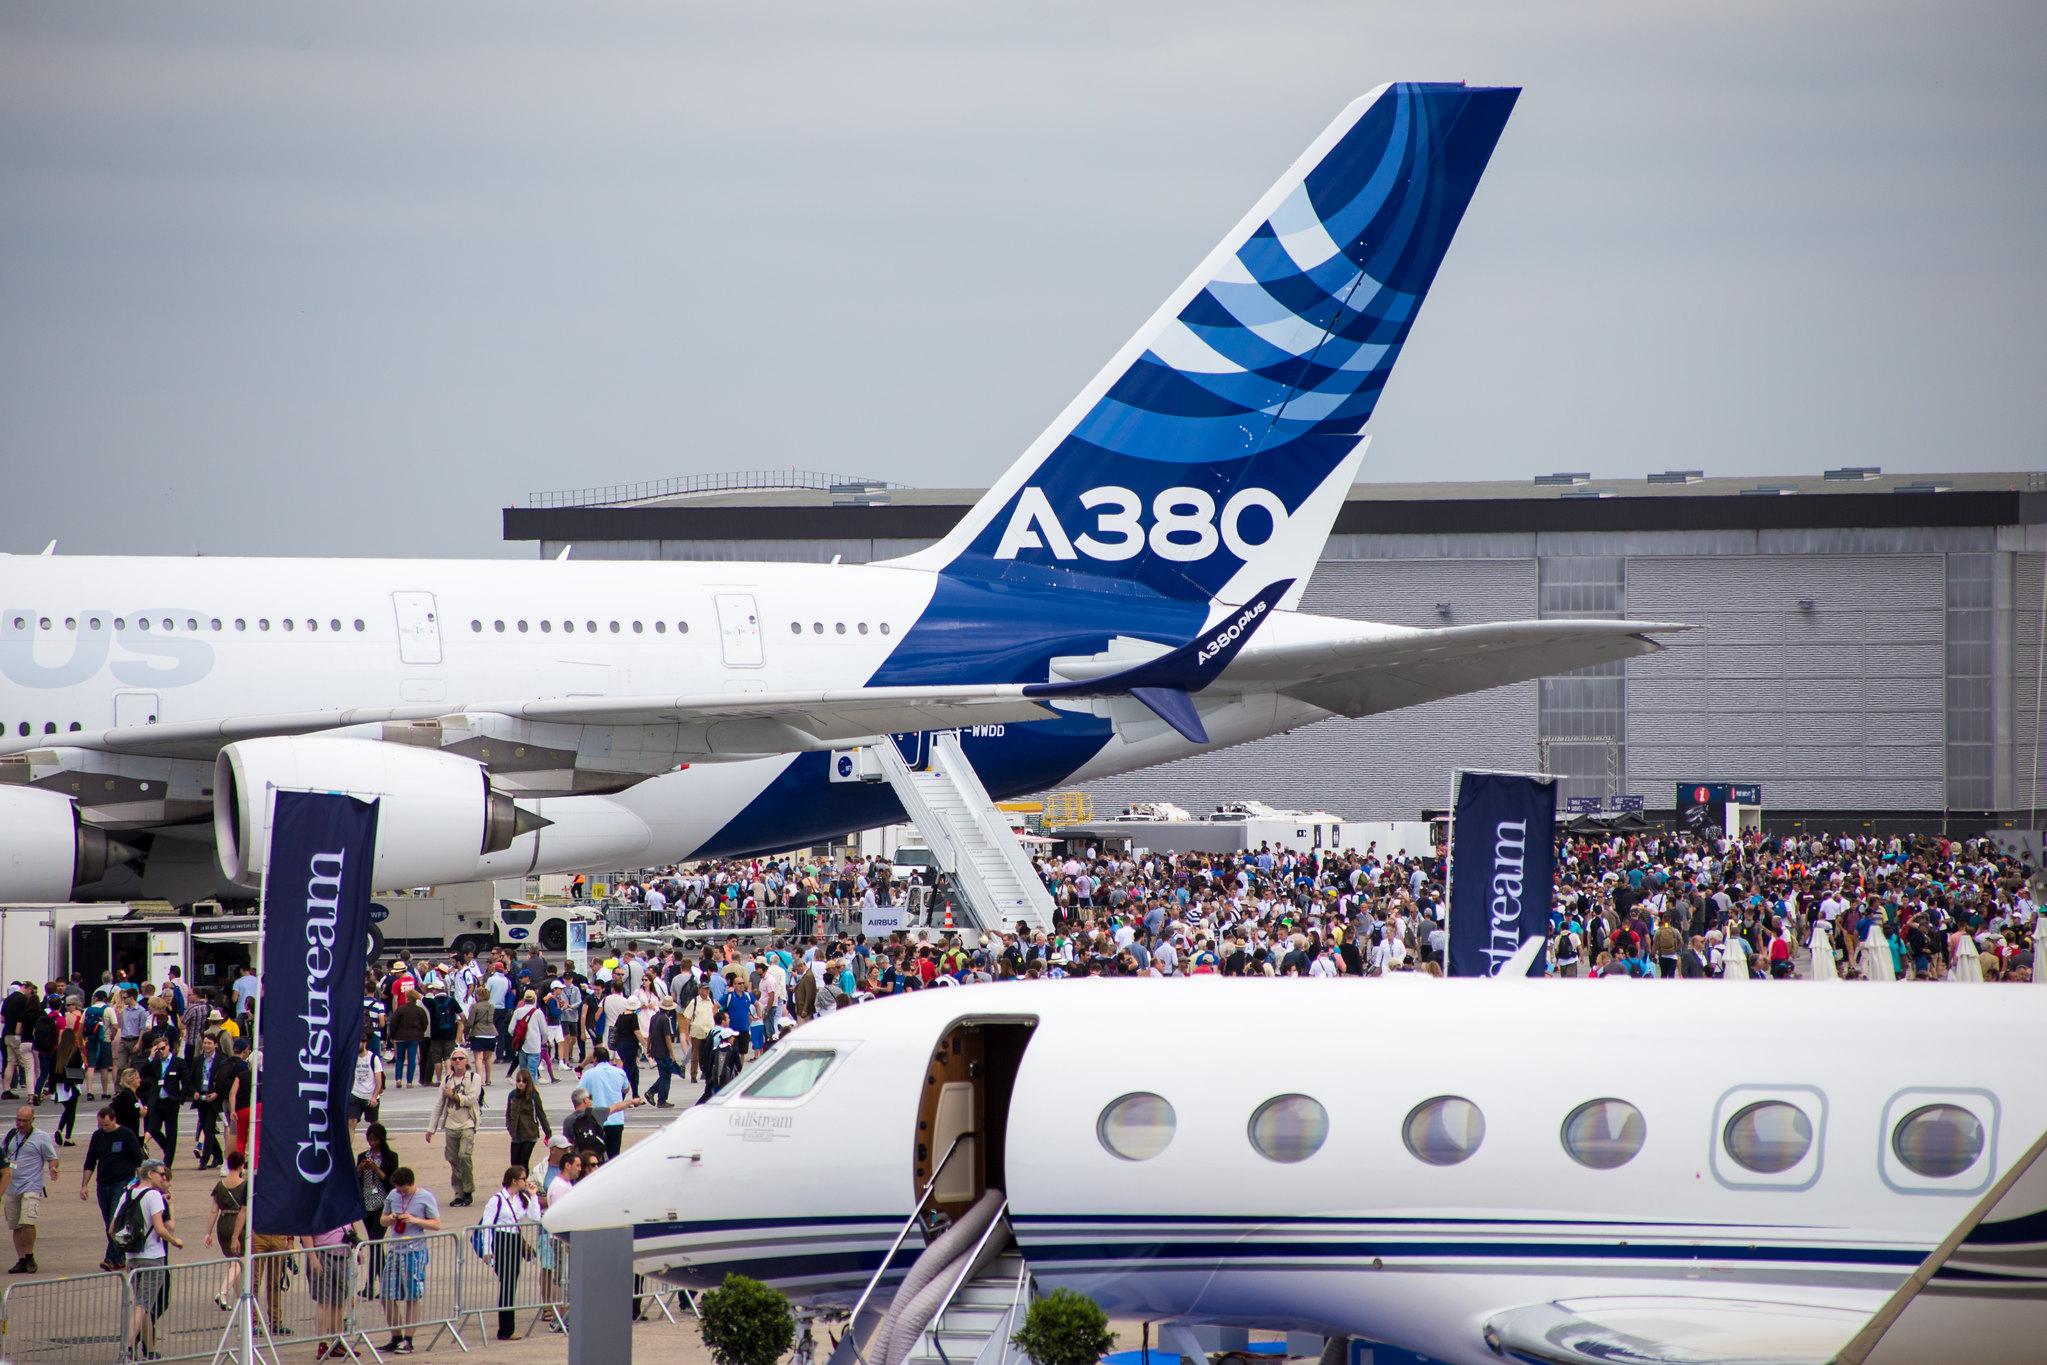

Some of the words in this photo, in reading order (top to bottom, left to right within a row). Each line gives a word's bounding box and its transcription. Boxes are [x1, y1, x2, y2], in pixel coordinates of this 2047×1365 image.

[993, 485, 1290, 562] A380
[956, 724, 1005, 738] -WWDD
[370, 911, 388, 919] WFS
[867, 918, 898, 926] AIRBUS
[295, 847, 345, 1184] Gulfstream
[728, 1111, 794, 1129] Gulfstream
